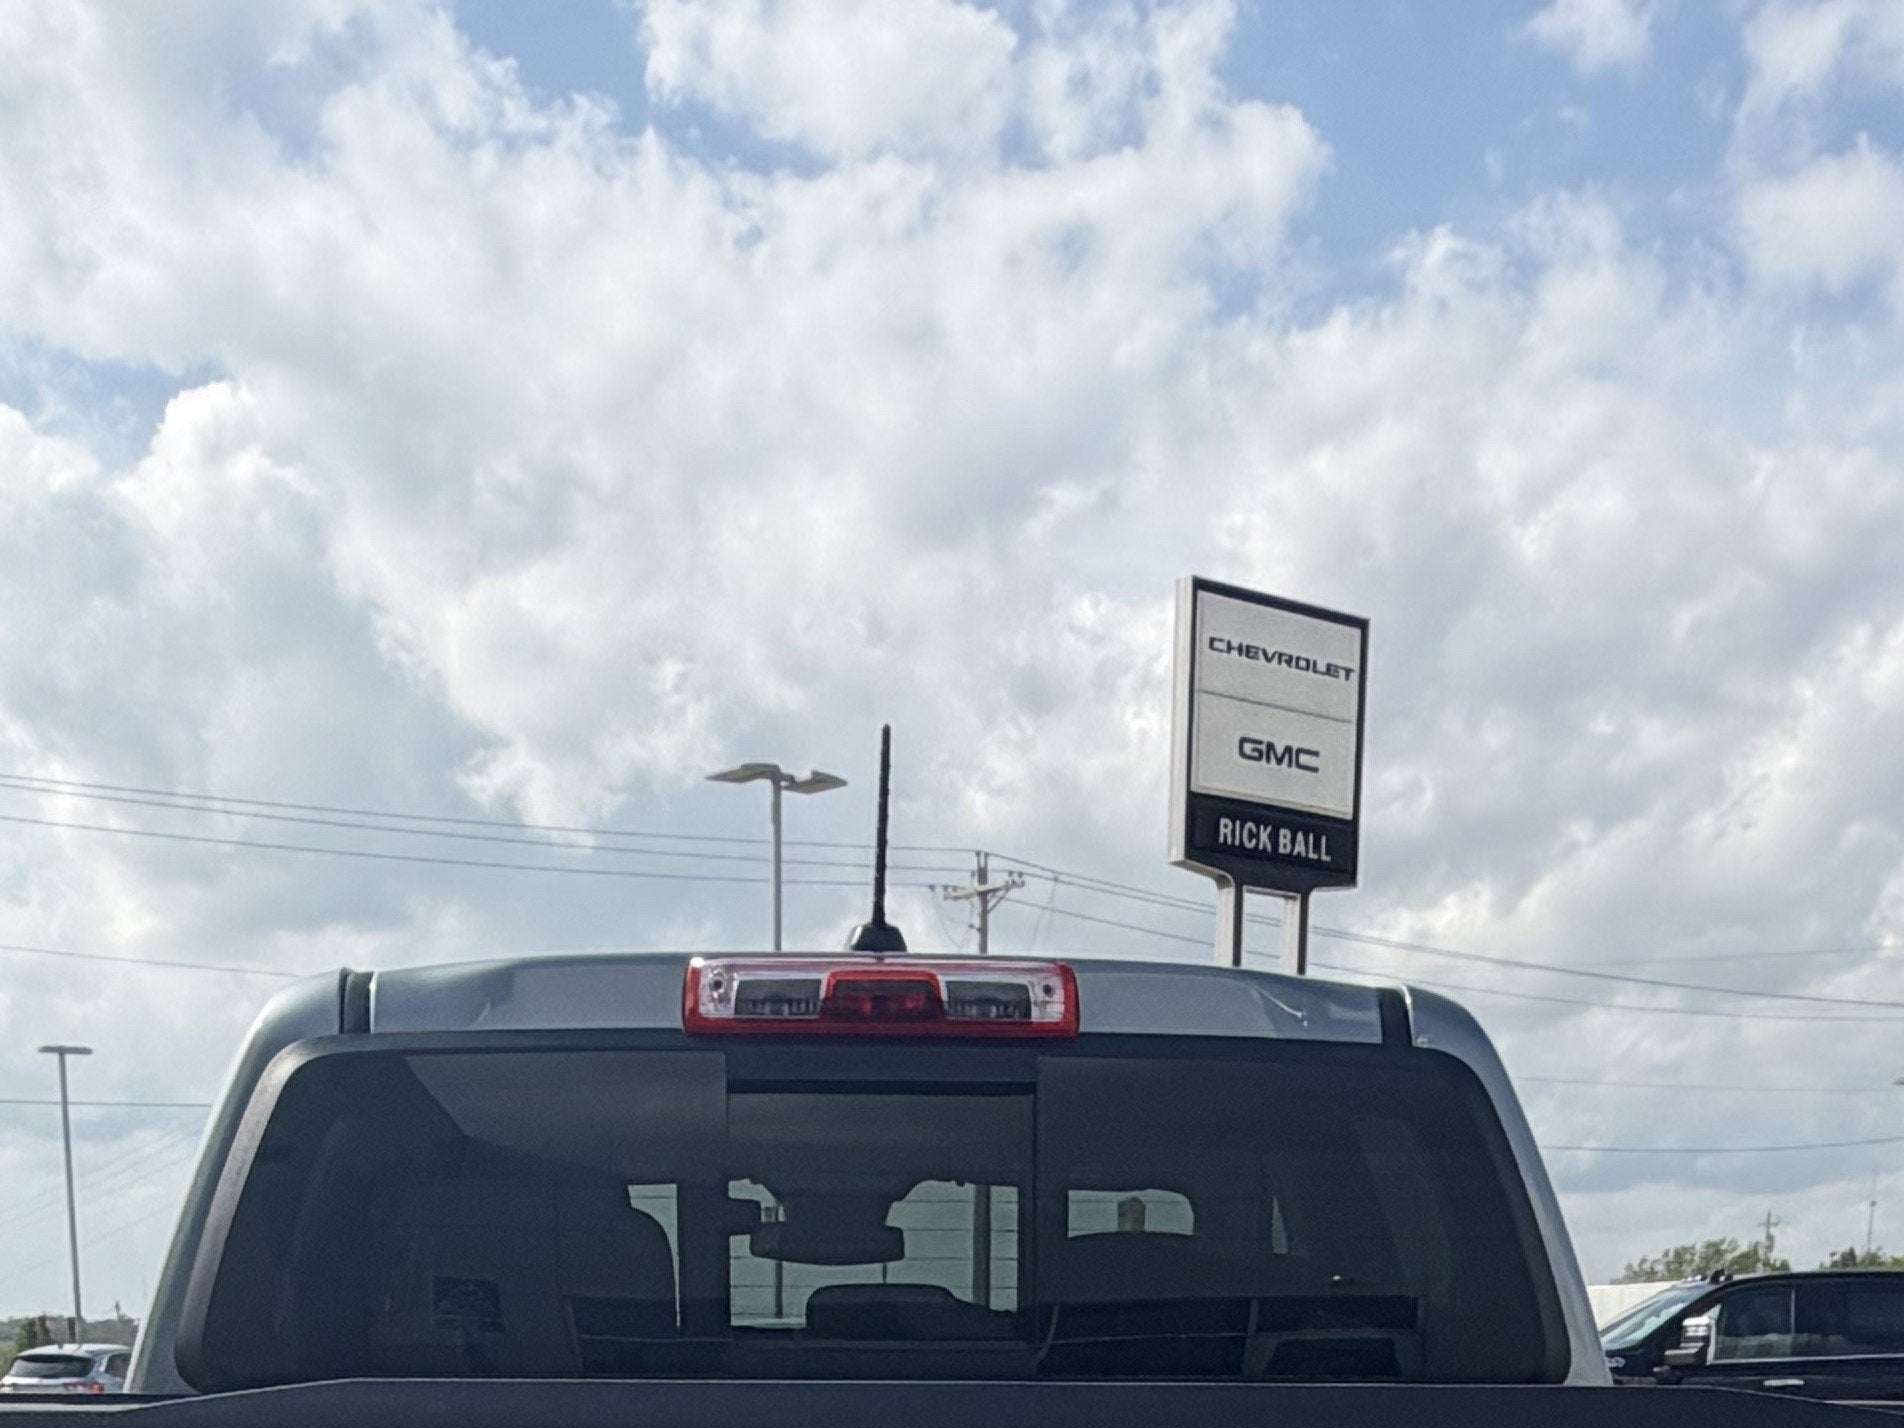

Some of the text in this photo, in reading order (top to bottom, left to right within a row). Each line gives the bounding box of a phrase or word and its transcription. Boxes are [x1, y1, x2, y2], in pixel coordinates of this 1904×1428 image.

[1208, 636, 1355, 681] CHEVROLET
[1238, 736, 1320, 773] GMC
[1218, 817, 1332, 862] RICK BALL
